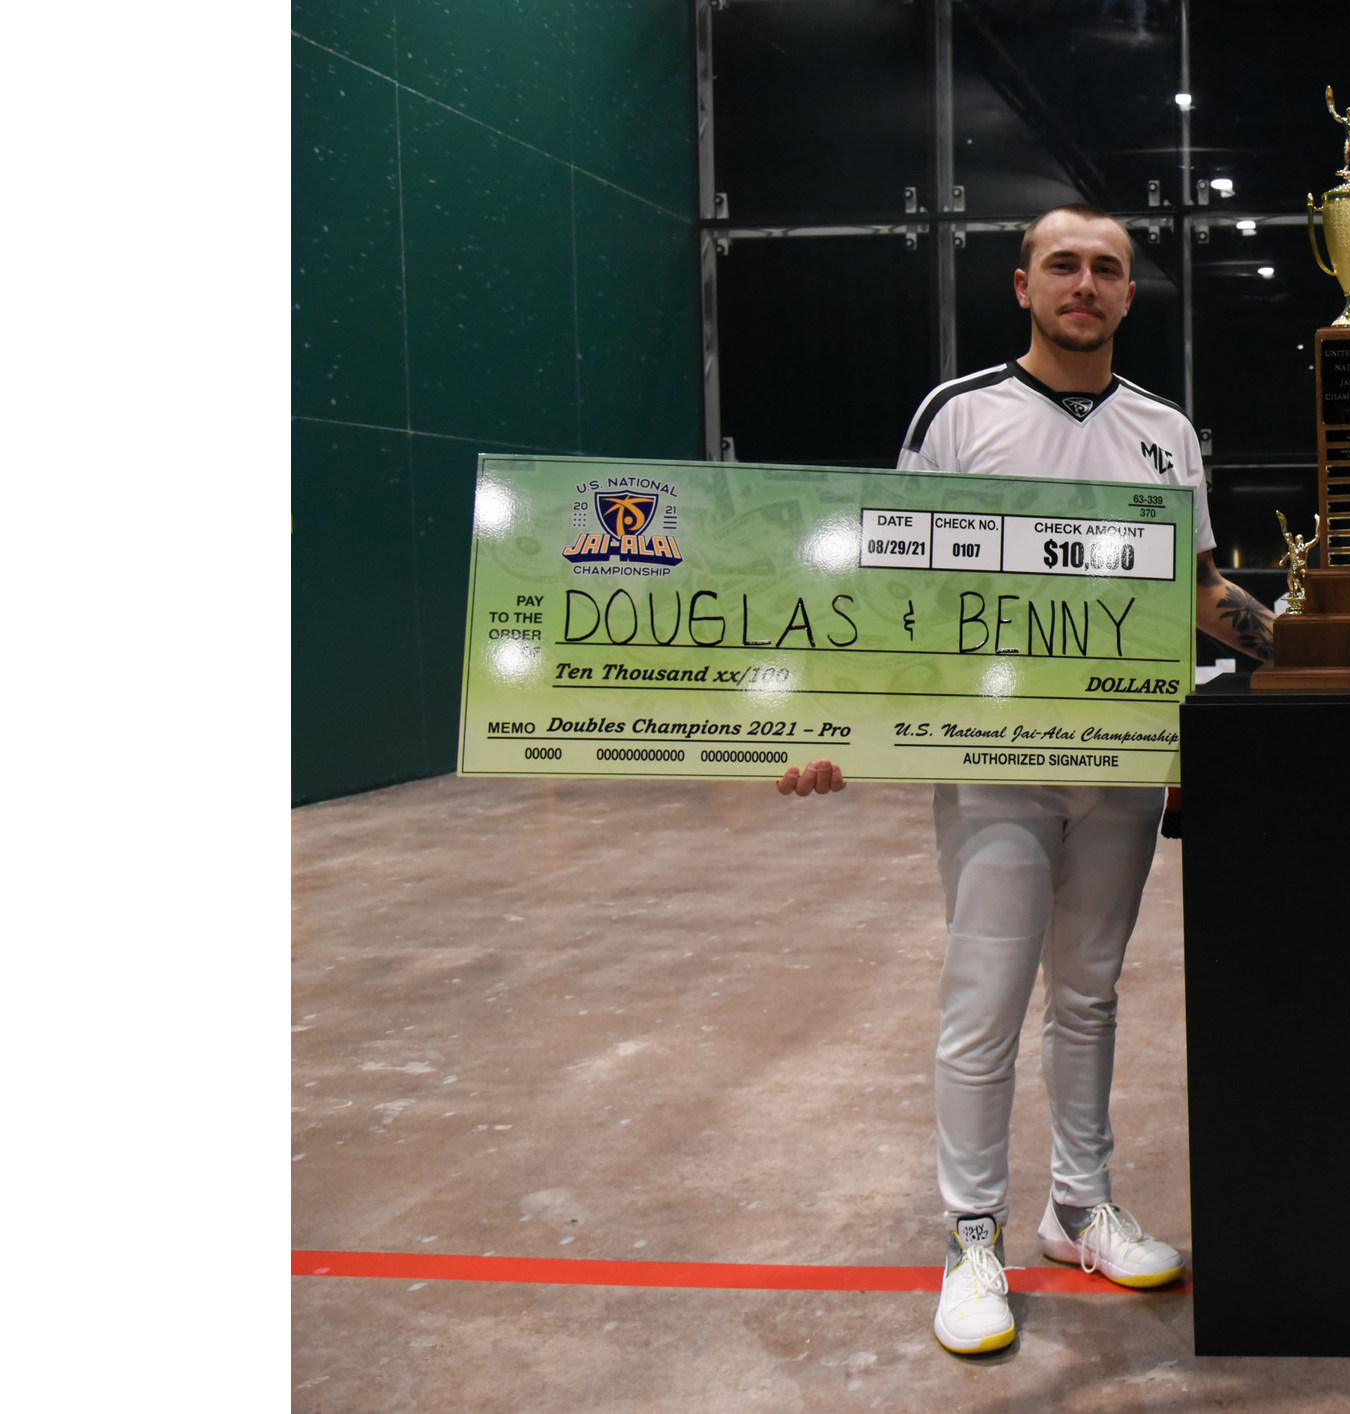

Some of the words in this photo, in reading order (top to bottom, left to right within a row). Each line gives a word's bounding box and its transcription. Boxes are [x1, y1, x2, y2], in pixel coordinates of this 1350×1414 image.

[576, 479, 602, 494] U.S.
[608, 477, 679, 497] NATIONAL
[1133, 494, 1163, 505] 63-339
[573, 501, 588, 511] 20
[665, 505, 677, 515] 21
[1140, 508, 1156, 518] 370
[877, 515, 913, 527] DATE
[935, 517, 975, 531] CHECK
[978, 520, 999, 531] NO.
[1034, 522, 1082, 535] CHECK
[1086, 524, 1145, 538] AMOUNT
[563, 533, 682, 562] JAI-ALAI
[868, 539, 925, 556] 08/29/21
[952, 543, 980, 558] 0107
[573, 565, 671, 577] CHAMPIONSHIP
[517, 595, 544, 606] PAY
[489, 612, 509, 623] TO
[514, 612, 543, 624] THE
[564, 588, 858, 648] DOUGLAS
[959, 591, 1136, 657] BENNY
[489, 629, 541, 640] ORDER
[555, 663, 593, 680] Ten
[602, 664, 707, 683] Thousand
[1085, 677, 1179, 695] DOLLARS
[488, 722, 536, 734] MEMO
[546, 717, 626, 734] Doubles
[632, 718, 742, 739] Champions
[747, 720, 797, 737] 2021
[818, 723, 851, 737] Pro
[894, 722, 933, 737] U.S.
[941, 723, 1006, 739] National
[1011, 725, 1075, 743] Jai-Alai
[1080, 726, 1180, 746] Championship
[597, 748, 685, 762] 000000000000
[700, 750, 788, 763] 000000000000
[963, 752, 1045, 766] AUTHORIZED
[1048, 753, 1119, 767] SIGNATURE
